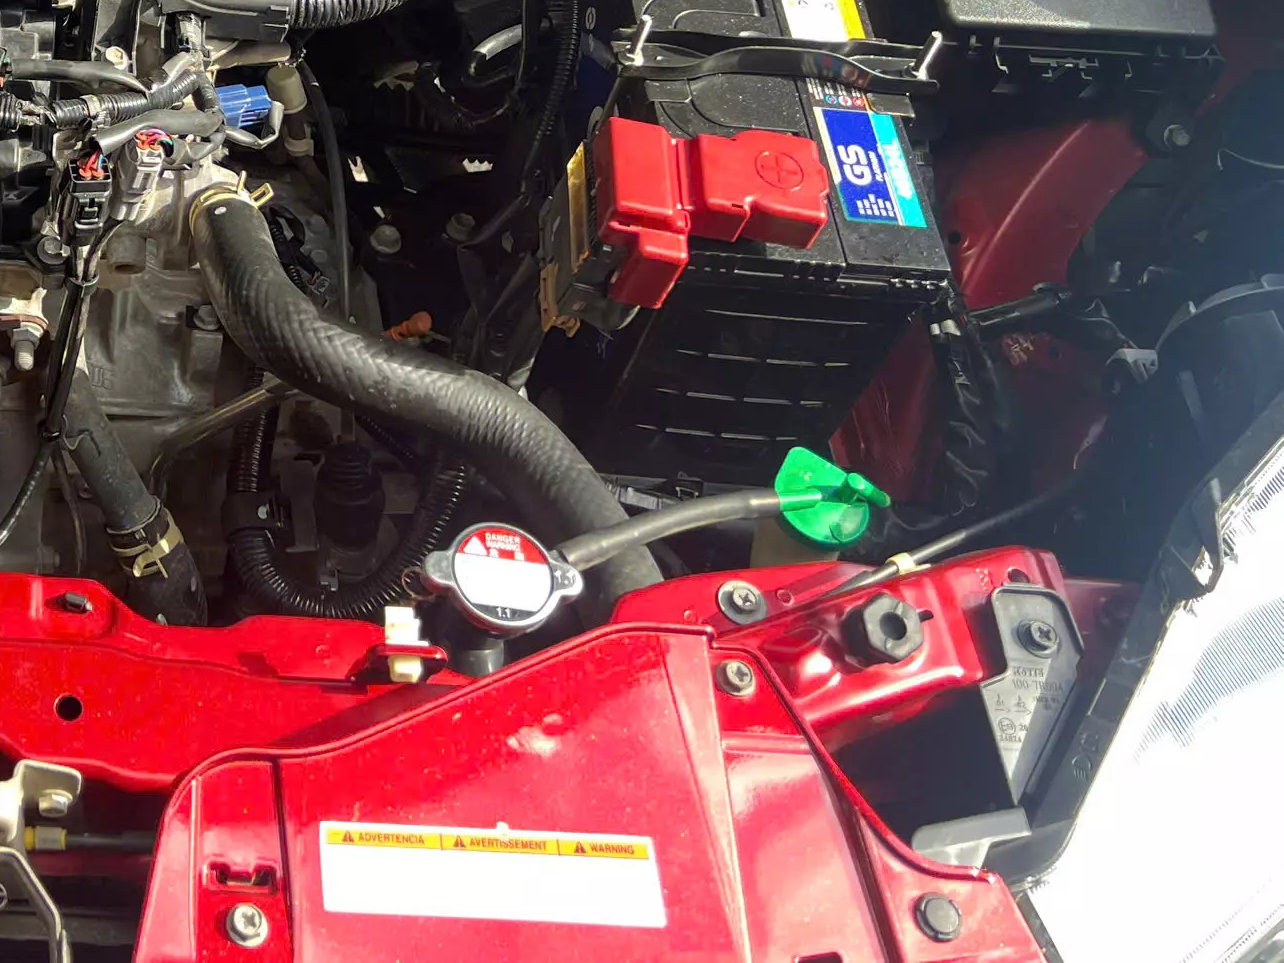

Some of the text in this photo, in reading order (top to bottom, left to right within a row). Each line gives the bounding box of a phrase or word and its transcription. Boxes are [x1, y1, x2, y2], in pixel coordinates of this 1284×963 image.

[836, 144, 873, 186] GS
[485, 532, 521, 544] DANGER
[358, 832, 635, 856] ADVERTENCIA AVERTISSEMENT WARNING
